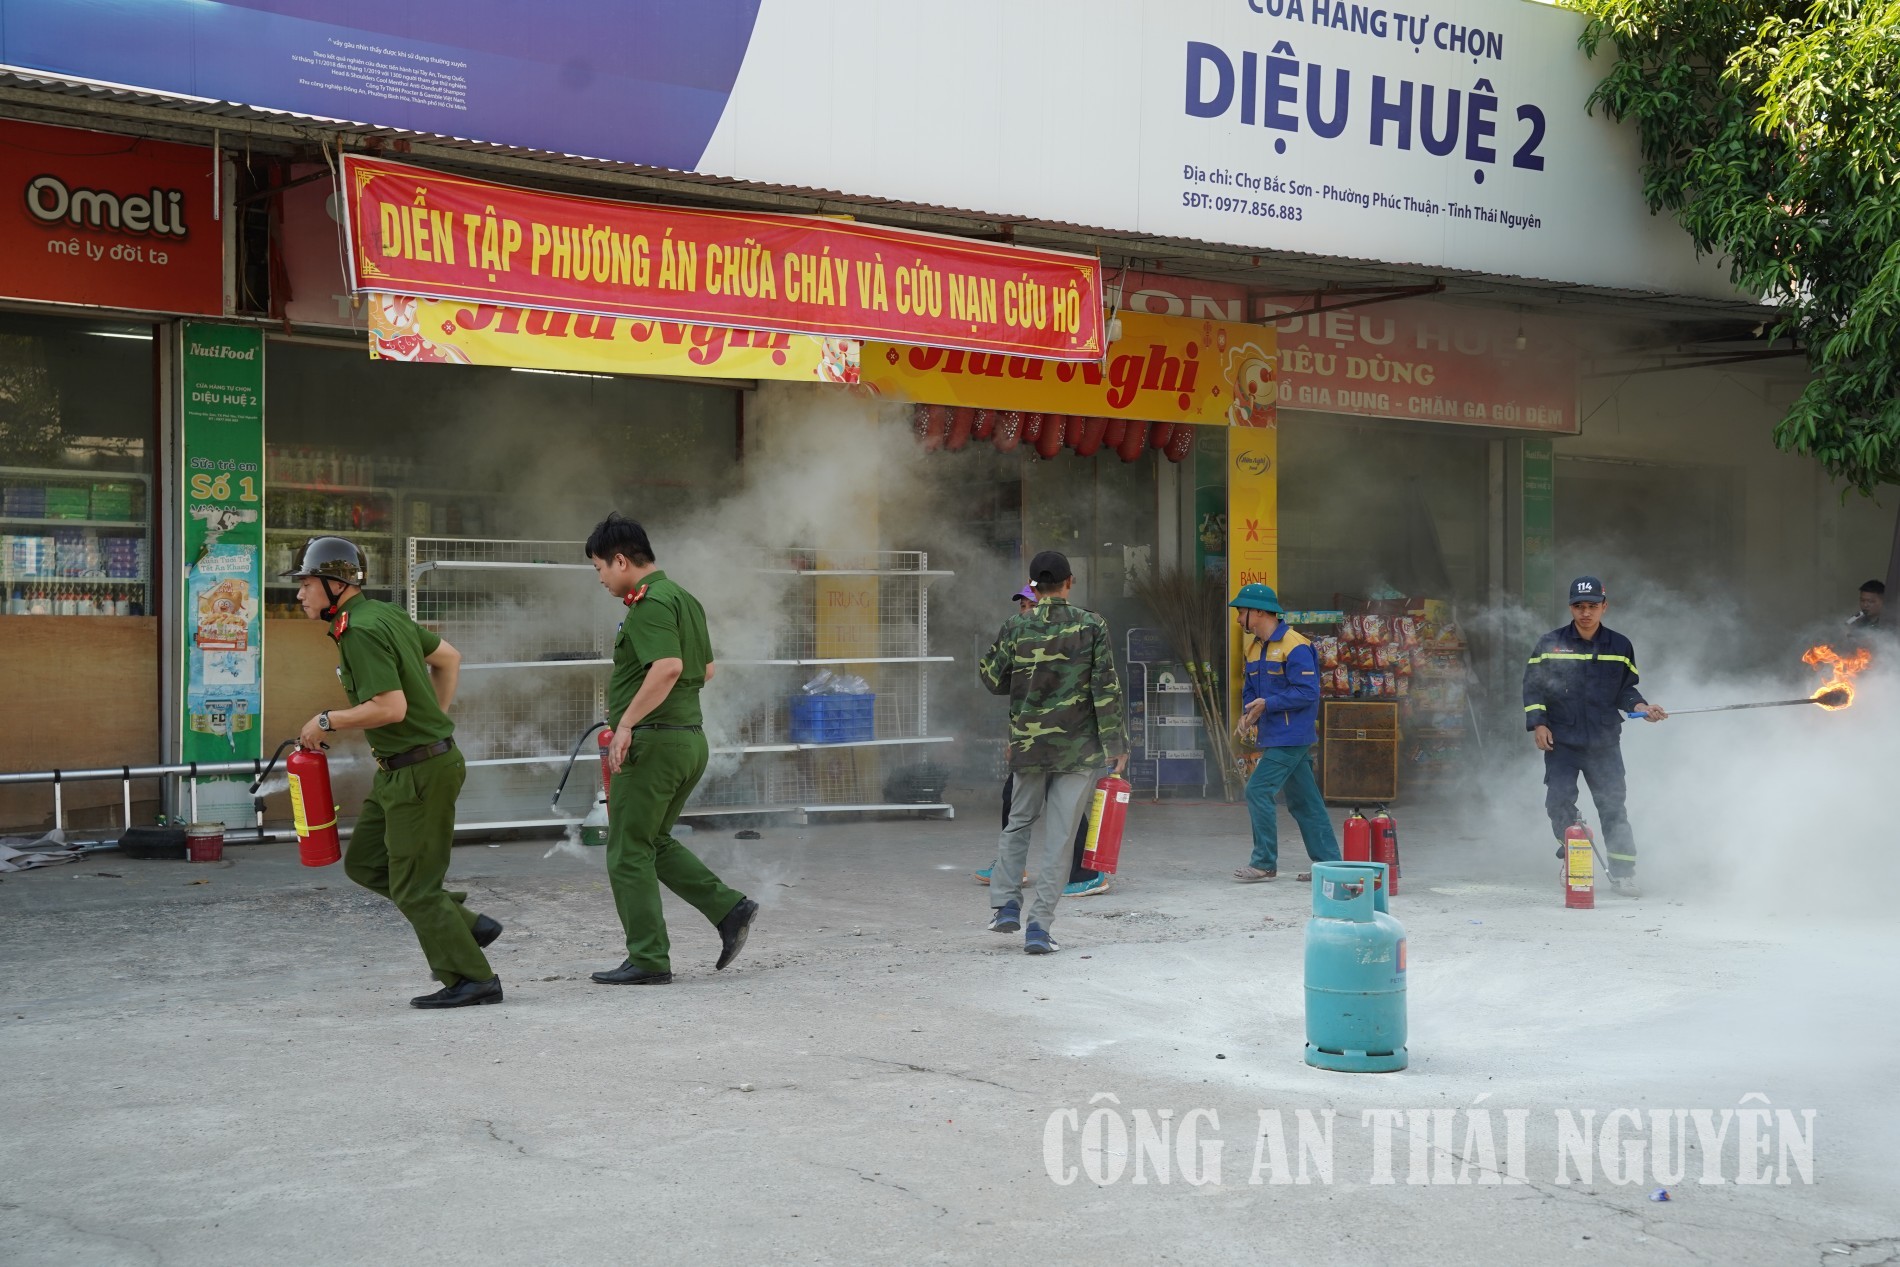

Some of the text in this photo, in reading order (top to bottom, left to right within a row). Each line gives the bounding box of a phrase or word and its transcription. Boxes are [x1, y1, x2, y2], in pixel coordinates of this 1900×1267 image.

[1394, 13, 1429, 53] TỰ
[1434, 22, 1503, 64] CHỌN
[332, 69, 345, 77] Head
[351, 72, 375, 81] Shoulders
[443, 88, 466, 97] Shampoo
[1185, 40, 1546, 184] DIỆU HUỆ 2
[27, 176, 187, 235] Omeli
[1183, 191, 1303, 222] SĐT: 0977.856.883
[1184, 165, 1206, 185] Địa
[1209, 169, 1232, 186] chỉ:
[1235, 172, 1261, 194] Chợ
[1264, 175, 1286, 193] Bắc
[1289, 180, 1312, 197] Sơn
[1323, 184, 1370, 208] Phường
[1373, 192, 1401, 210] Phúc
[1404, 196, 1438, 217] Thuận
[1448, 202, 1471, 219] Tỉnh
[1474, 206, 1497, 222] Thái
[1500, 210, 1541, 230] Nguyên
[47, 237, 168, 265] mê ly đời ta
[379, 187, 1081, 344] DIỄN TẬP PHƯƠNG ÁN CHỮA CHÁY VÀ CỨU NẠN CỨU HỘ
[1264, 303, 1396, 349] DIỆU
[189, 342, 255, 361] NutiFood
[1346, 353, 1436, 386] DÙNG
[192, 390, 257, 407] DIỆU HUỆ 2
[1300, 385, 1332, 406] GIA
[1338, 388, 1389, 411] DỤNG
[1408, 395, 1458, 417] CHĂN
[1464, 401, 1487, 419] GA
[191, 457, 257, 472] Sữa trẻ em
[191, 473, 258, 502] Số 1
[826, 591, 870, 609] TRUNG
[1577, 582, 1593, 591] 114
